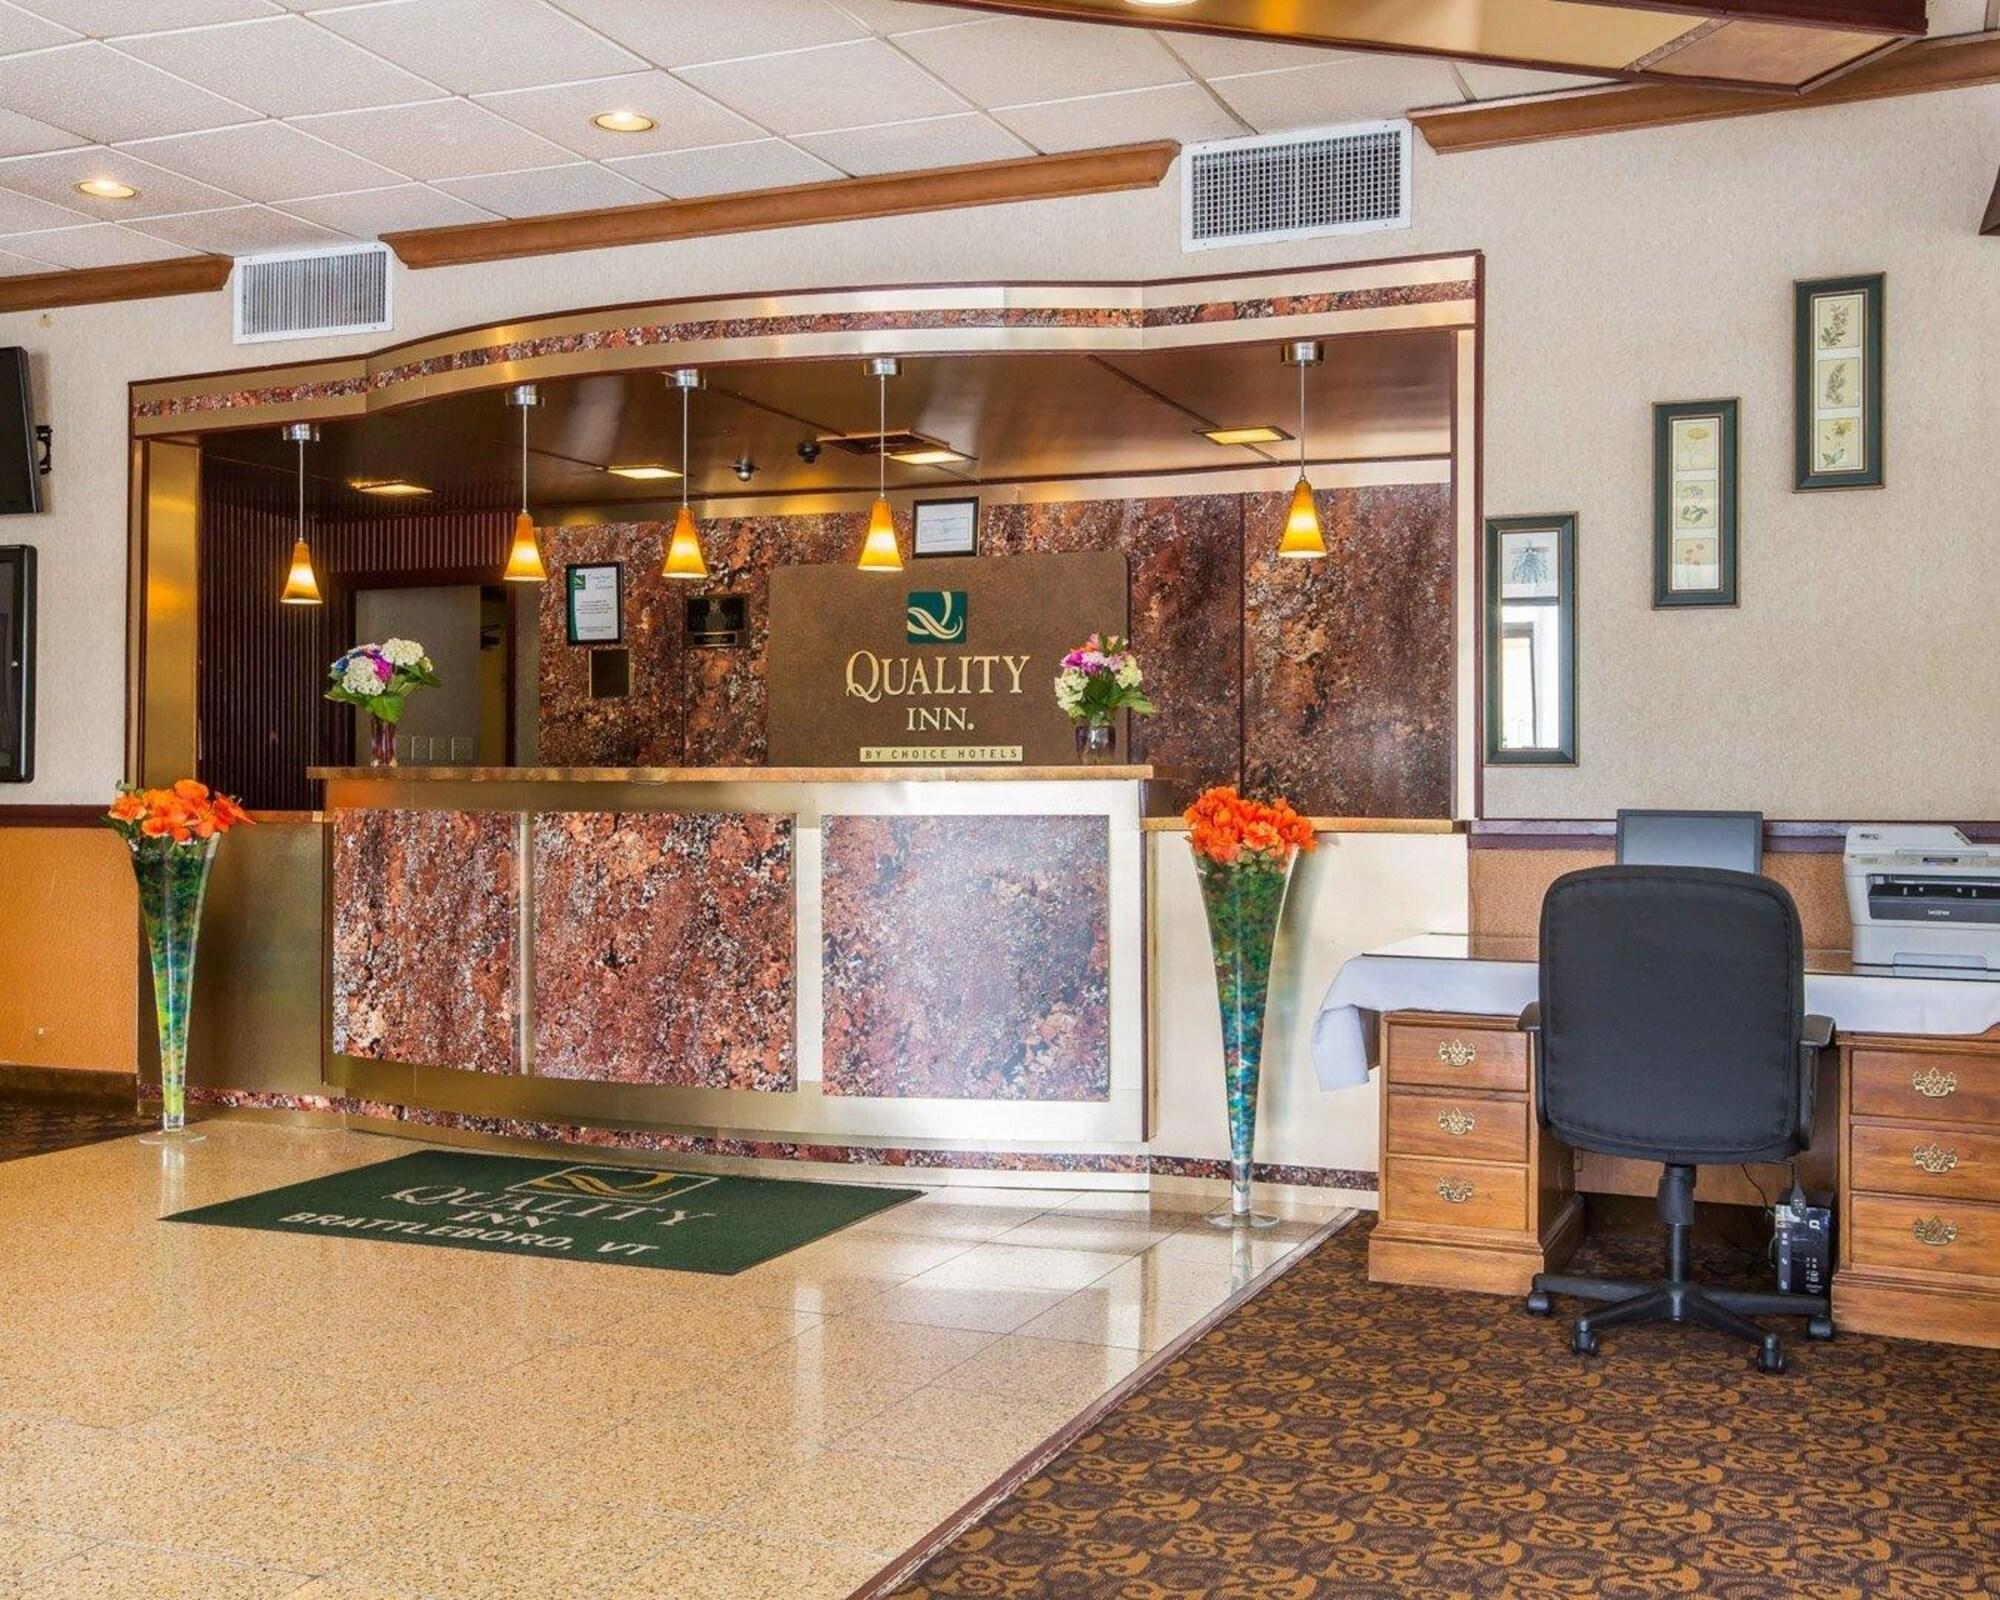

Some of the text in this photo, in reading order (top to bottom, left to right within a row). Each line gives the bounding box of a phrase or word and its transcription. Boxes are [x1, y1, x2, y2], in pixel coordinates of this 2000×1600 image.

[845, 650, 1030, 703] QUALITY
[865, 748, 1017, 760] BY CHOICE HOTELS
[381, 1185, 717, 1226] QUALITY
[447, 1210, 559, 1228] INN
[277, 1212, 660, 1256] BRATTLEBORO, VT
